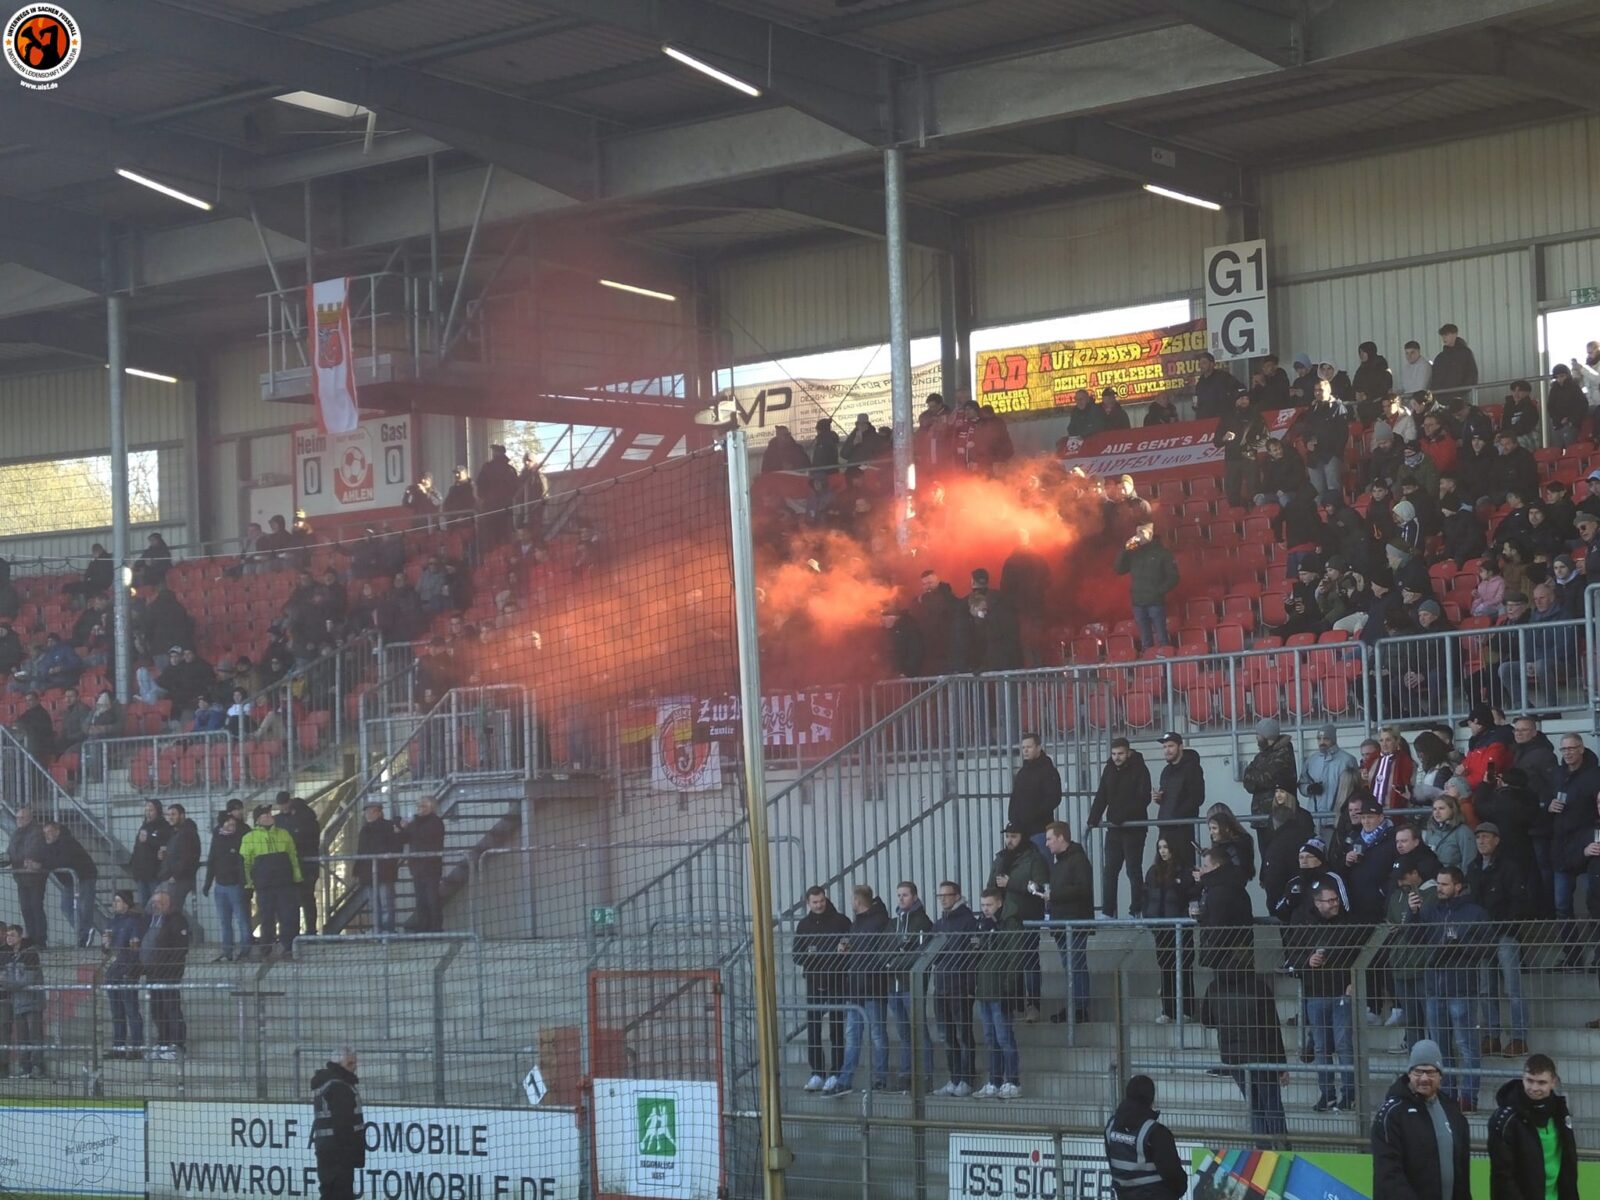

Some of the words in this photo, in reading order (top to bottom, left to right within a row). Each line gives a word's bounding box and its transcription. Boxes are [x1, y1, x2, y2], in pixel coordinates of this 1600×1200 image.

[1208, 247, 1264, 297] G1
[1221, 309, 1255, 355] G
[1039, 329, 1208, 374] AUFKLEBER-DESIG
[982, 355, 1028, 392] AD
[1054, 374, 1087, 392] DEINE
[1090, 363, 1163, 387] AUFKLEBER
[983, 389, 1029, 401] AUFKLEBER
[297, 434, 327, 455] Heim
[381, 421, 407, 442] Gast
[1101, 442, 1133, 455] AUF
[1137, 434, 1193, 452] GEHT'S
[305, 459, 319, 494] 0
[387, 447, 401, 483] 0
[342, 487, 374, 501] AHLEN
[231, 1117, 298, 1149] ROLF
[962, 1163, 1003, 1198] ISS
